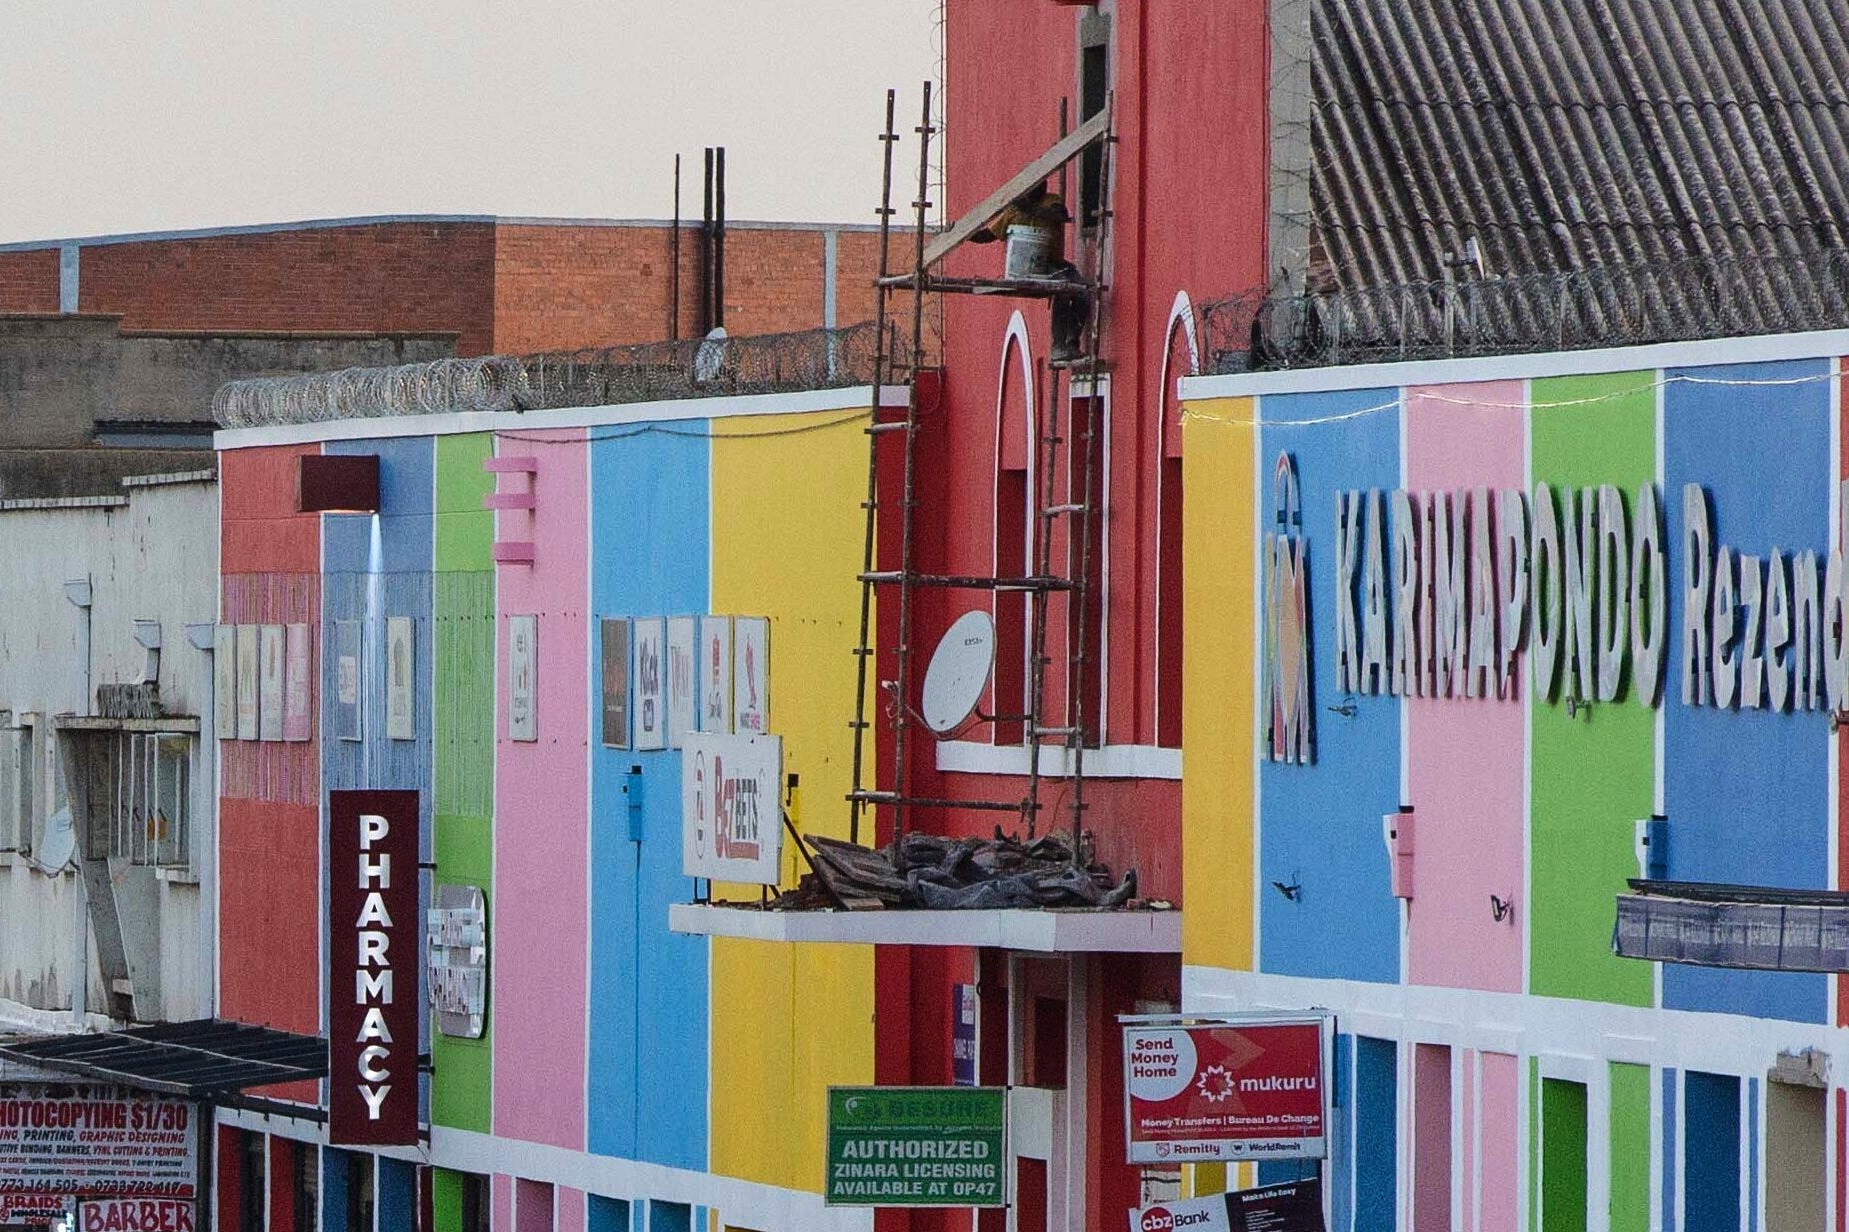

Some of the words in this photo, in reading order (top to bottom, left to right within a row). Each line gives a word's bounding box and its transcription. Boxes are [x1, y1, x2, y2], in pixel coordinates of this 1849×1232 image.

[1335, 481, 1664, 708] KARIMAPONDO
[355, 814, 394, 1120] PHARMACY
[1135, 1037, 1173, 1051] Send
[1131, 1052, 1179, 1066] Money
[1134, 1065, 1177, 1078] Home
[1240, 1076, 1316, 1092] mukuru
[130, 1103, 189, 1131] $1/30
[1141, 1117, 1173, 1129] Money
[1175, 1115, 1222, 1127] Transfers
[1228, 1114, 1266, 1125] Bureau
[1280, 1113, 1320, 1125] Change
[23, 1128, 76, 1143] PRINTING,
[79, 1130, 125, 1143] GRAPHIC
[127, 1131, 185, 1144] DESIGNING
[842, 1140, 988, 1159] AUTHORIZED
[1174, 1142, 1221, 1155] Remitly
[834, 1163, 899, 1178] ZINARA
[903, 1163, 995, 1178] LICENSING
[833, 1181, 922, 1196] AVAILABLE
[928, 1182, 948, 1195] AT
[4, 1195, 63, 1209] BRAIDS
[84, 1200, 194, 1232] BARBER
